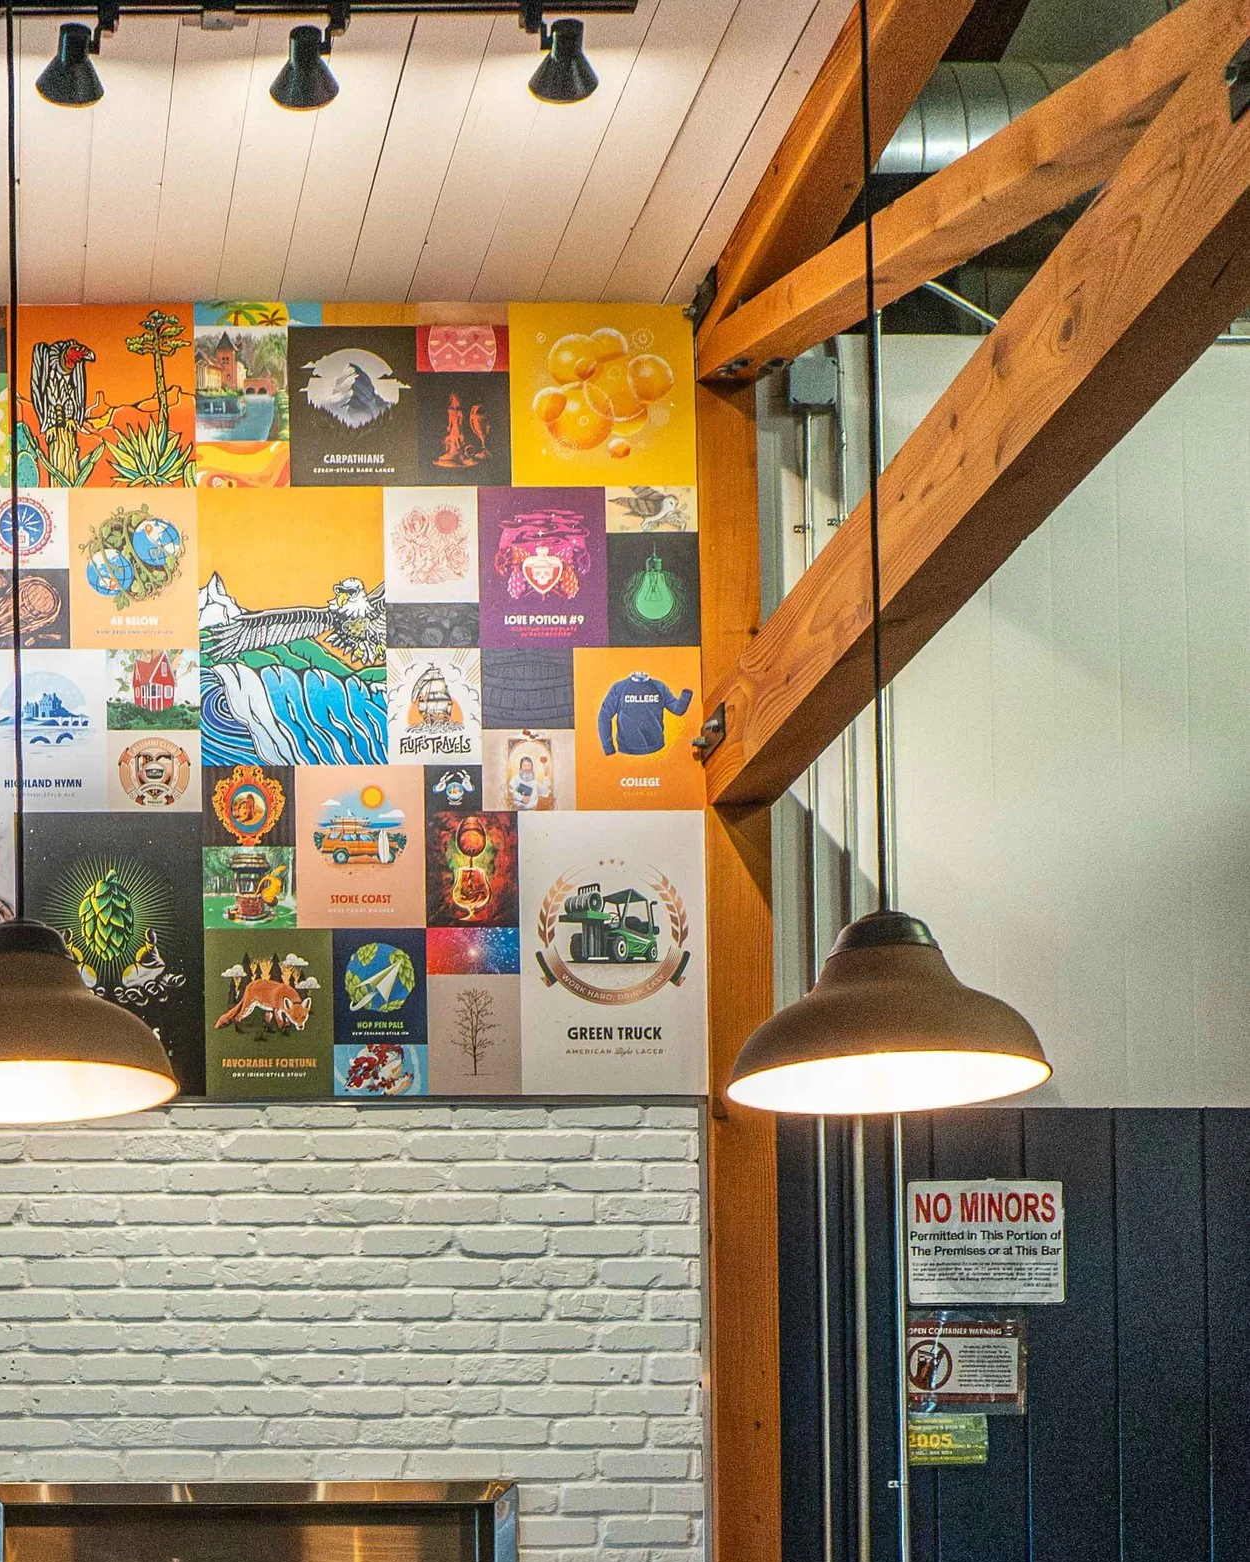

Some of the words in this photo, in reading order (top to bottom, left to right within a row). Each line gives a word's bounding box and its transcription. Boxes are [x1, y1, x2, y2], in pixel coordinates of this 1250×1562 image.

[323, 454, 385, 464] CARPATHIANS
[504, 615, 527, 625] LOVE
[529, 615, 567, 625] POTION
[569, 614, 585, 625] #9
[624, 694, 660, 703] COLLEGE
[426, 735, 471, 754] TRAVELS
[54, 779, 82, 788] HYMN
[620, 777, 661, 787] COLLEGE
[330, 894, 359, 904] STOKE
[361, 894, 391, 904] COAST
[562, 973, 586, 993] WORK
[617, 988, 644, 1001] DRINK
[357, 1021, 373, 1029] HOP
[374, 1021, 387, 1029] PEN
[388, 1021, 404, 1029] PALS
[567, 1026, 613, 1040] GREEN
[617, 1026, 662, 1040] TRUCK
[222, 1058, 273, 1068] FAVORABLE
[276, 1058, 318, 1068] FORTUNE
[915, 1192, 952, 1223] NO
[960, 1191, 1056, 1223] MINORS
[910, 1231, 965, 1241] Permitted
[967, 1230, 977, 1240] in
[980, 1230, 1004, 1240] This
[1006, 1230, 1048, 1241] Portion
[1050, 1230, 1062, 1240] of
[910, 1246, 931, 1256] The
[934, 1246, 986, 1256] Premises
[988, 1248, 1000, 1256] or
[1002, 1246, 1013, 1256] at
[1015, 1246, 1038, 1256] This
[1041, 1246, 1062, 1256] Bar
[908, 1327, 927, 1335] OPEN
[969, 1327, 1003, 1336] WARNING
